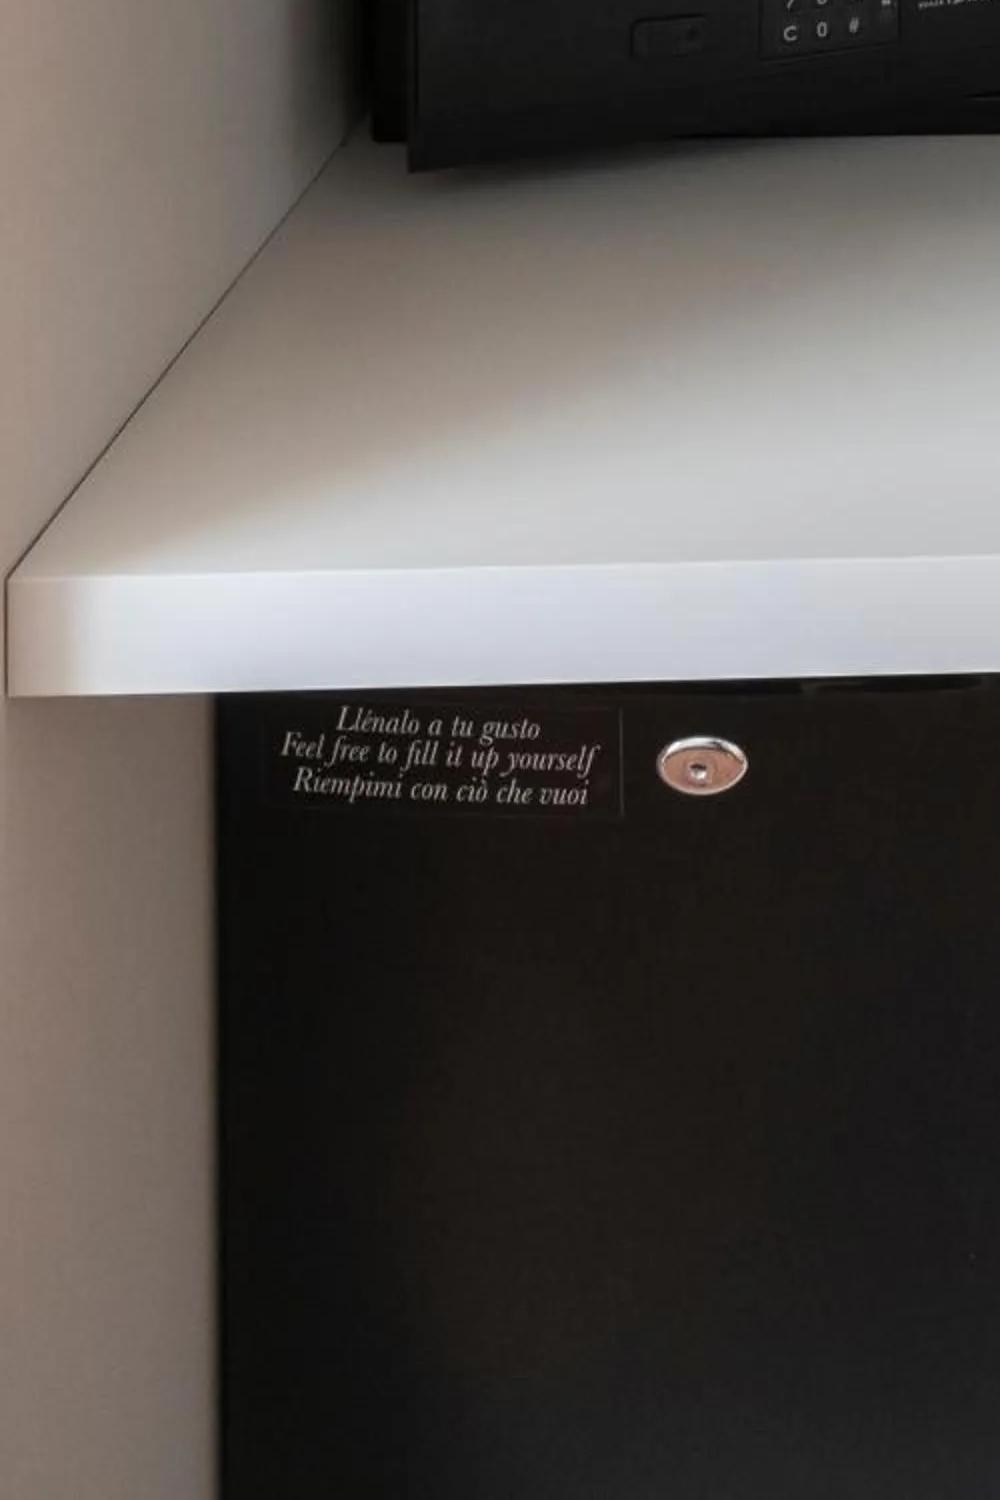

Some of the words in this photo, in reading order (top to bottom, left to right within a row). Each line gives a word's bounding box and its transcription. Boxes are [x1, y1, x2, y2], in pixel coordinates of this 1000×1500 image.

[783, 25, 797, 41] C
[336, 704, 420, 734] Llénalo
[428, 718, 443, 736] a
[451, 716, 474, 737] tu
[479, 718, 541, 746] gusto
[280, 731, 326, 759] Feel
[323, 735, 370, 768] free
[377, 741, 398, 764] to
[400, 739, 440, 772] fill
[446, 741, 463, 768] it
[471, 747, 499, 776] up
[500, 744, 601, 779] yourself
[292, 765, 404, 804] Riempimi
[410, 782, 448, 801] con
[456, 776, 488, 802] ciò
[497, 778, 533, 804] che
[538, 779, 588, 805] vuoi
